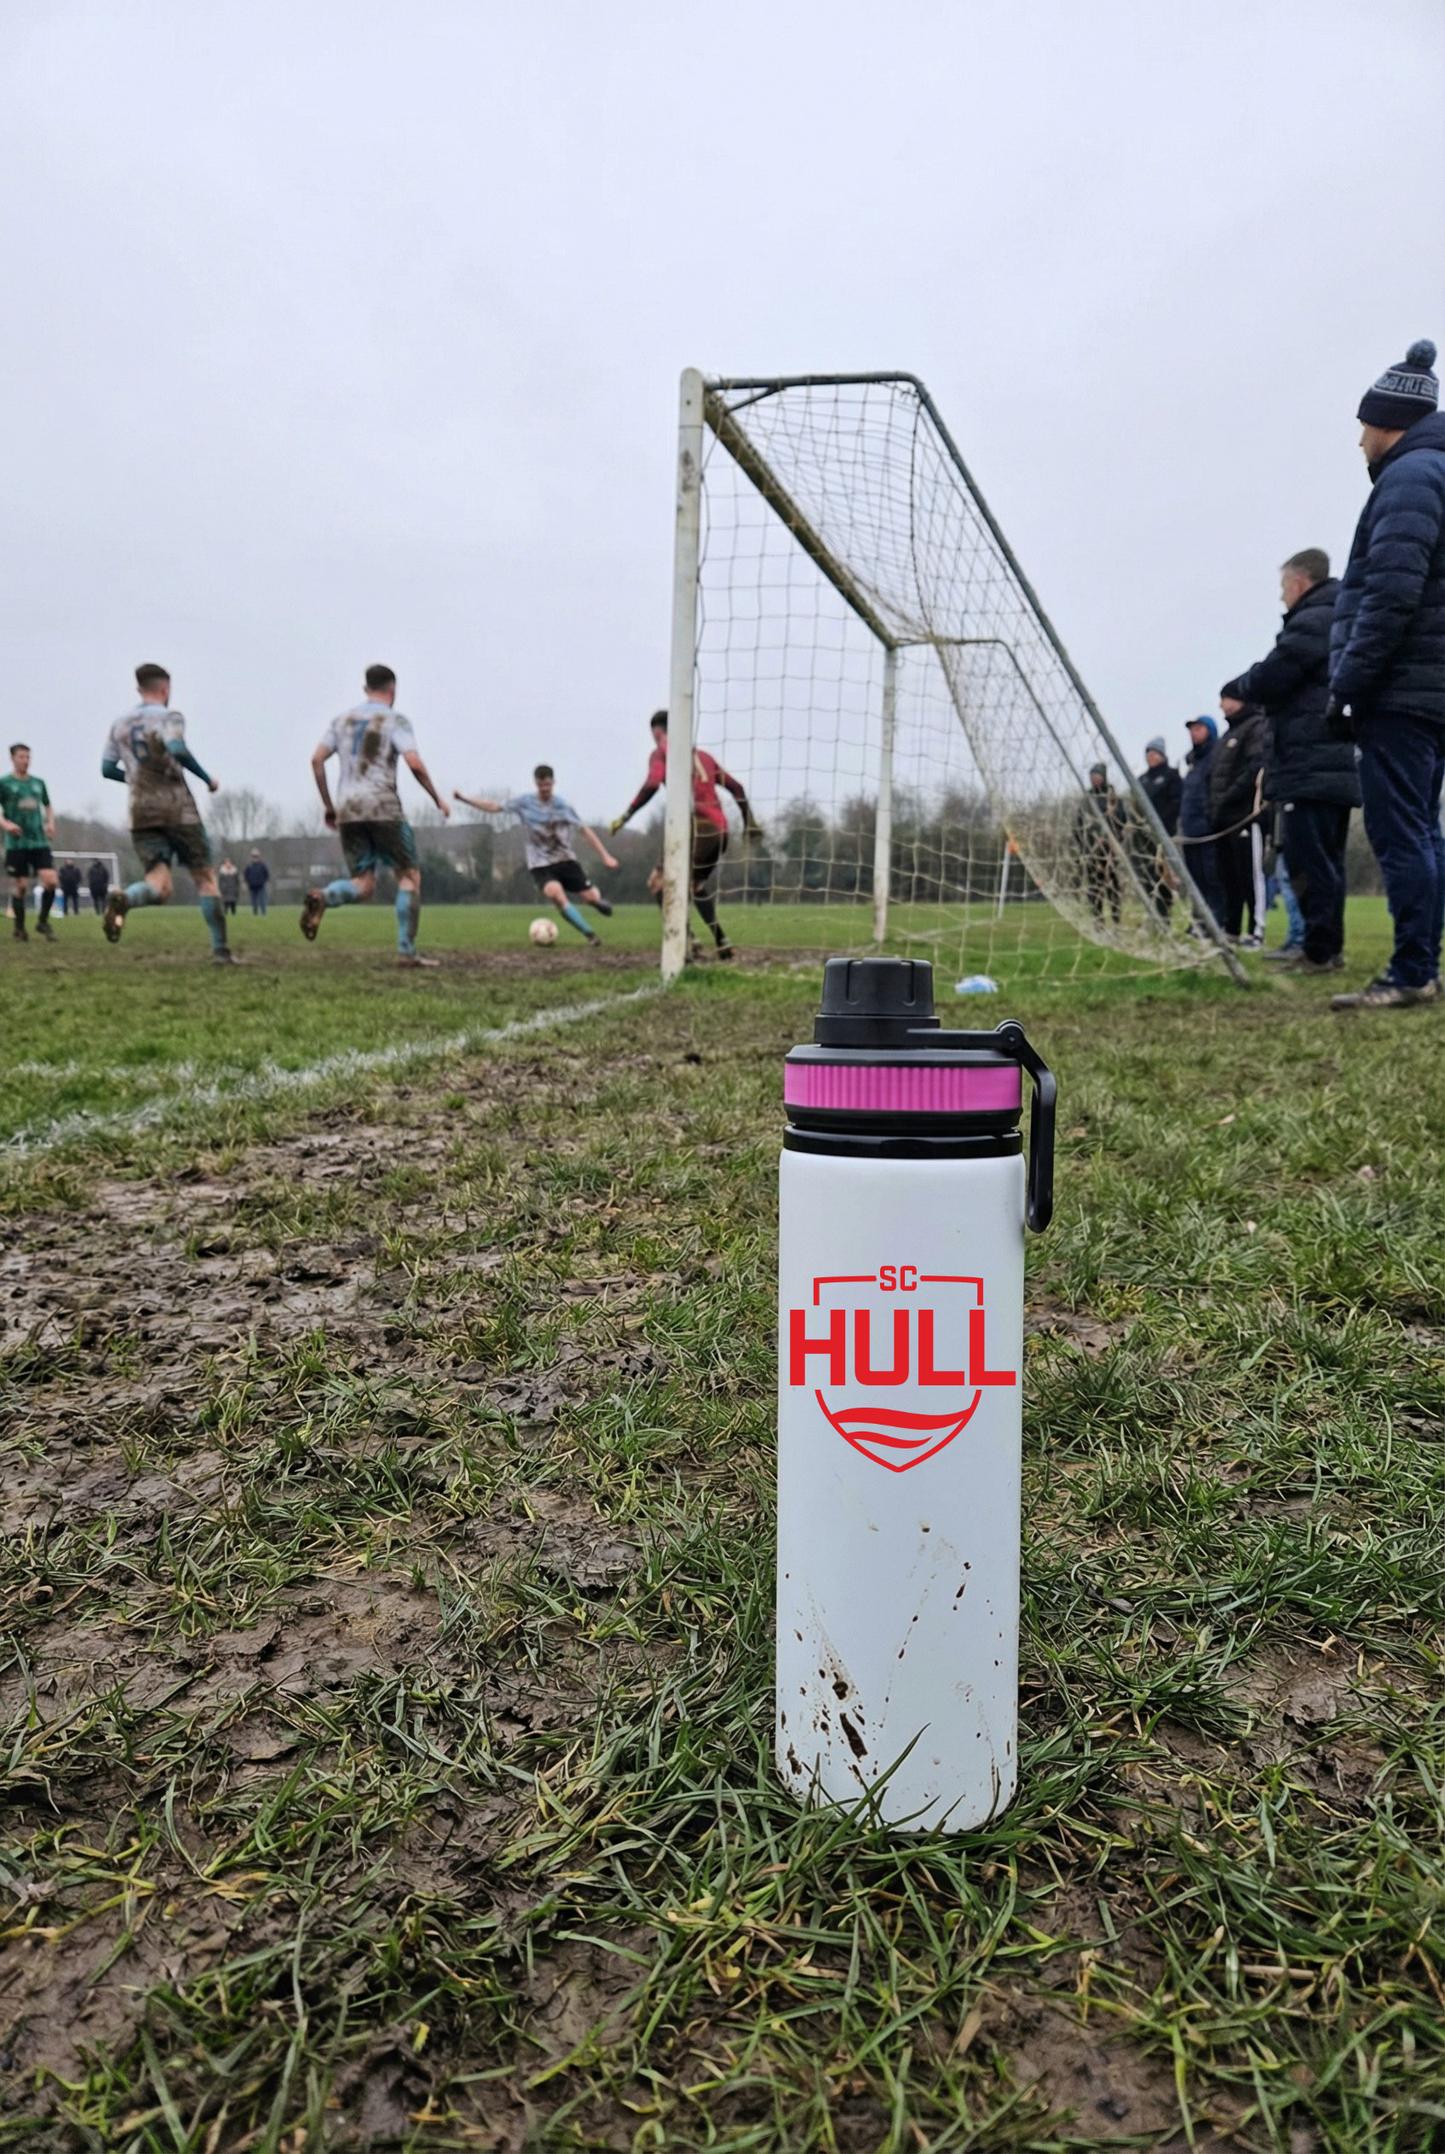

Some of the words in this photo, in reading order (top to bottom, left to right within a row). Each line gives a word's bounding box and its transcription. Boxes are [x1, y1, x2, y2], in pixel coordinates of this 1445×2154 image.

[130, 724, 150, 763] 6
[351, 719, 369, 757] 7
[879, 1265, 917, 1291] SC
[790, 1309, 1016, 1386] HULL
